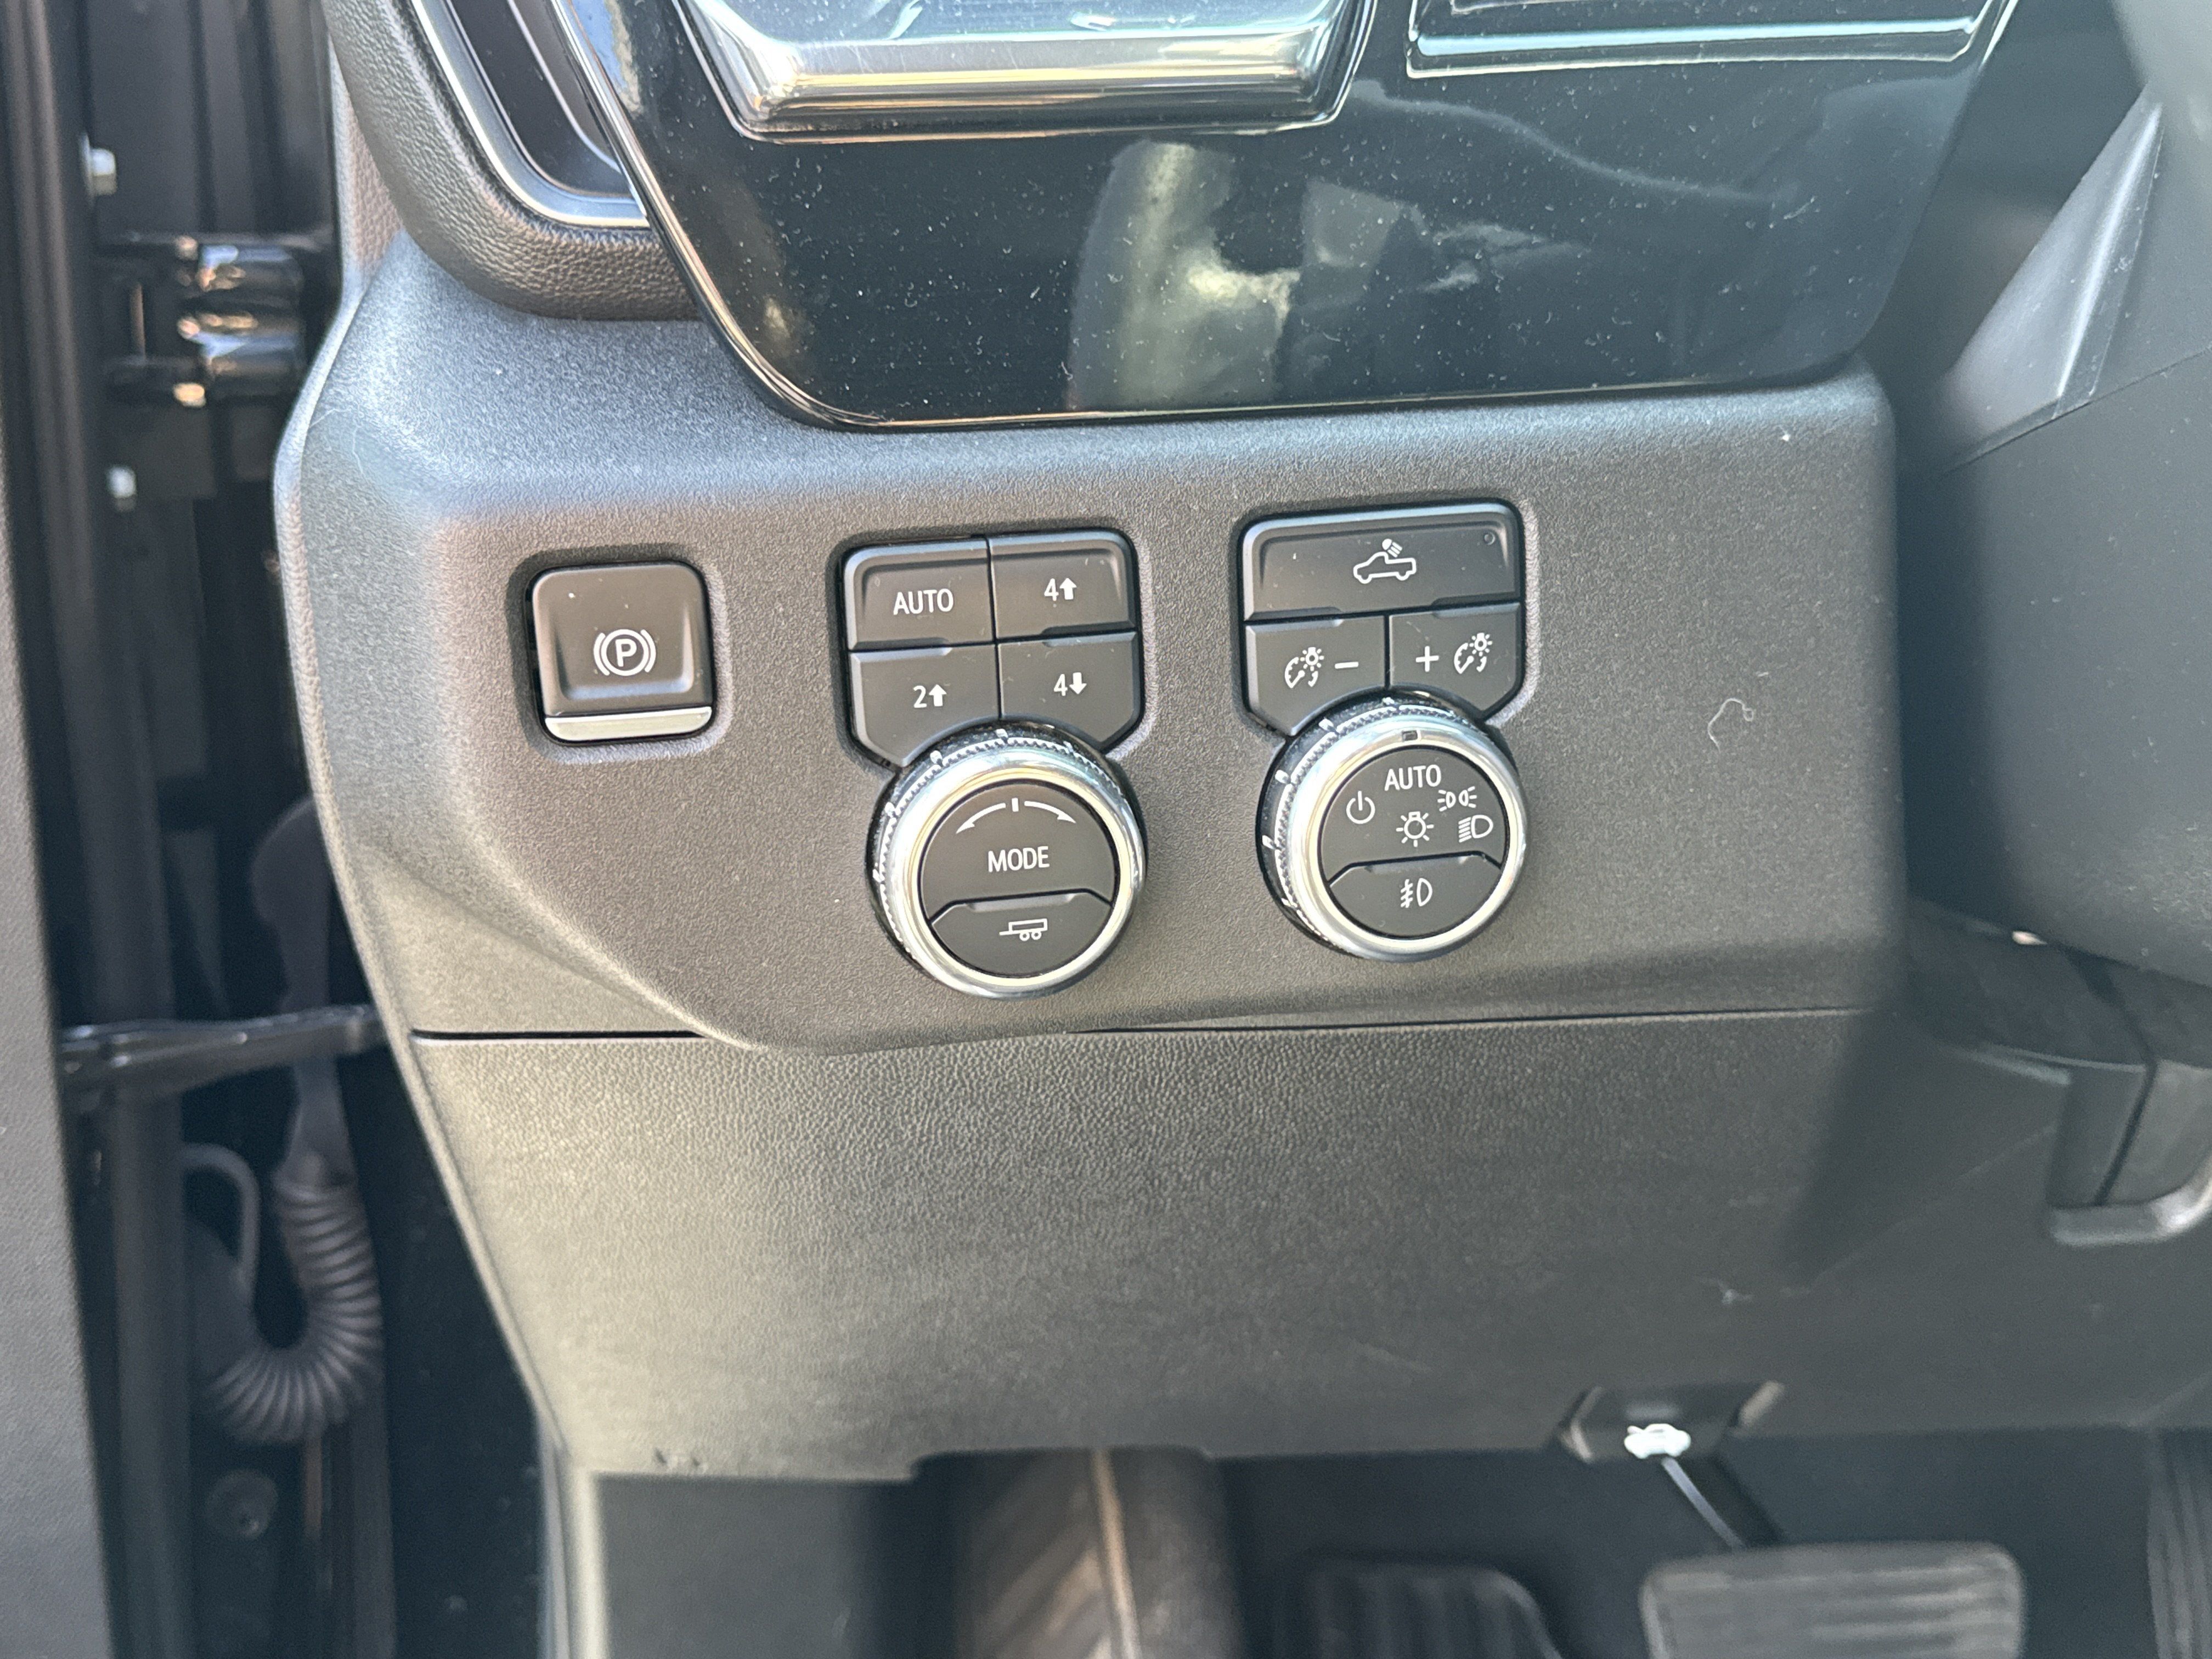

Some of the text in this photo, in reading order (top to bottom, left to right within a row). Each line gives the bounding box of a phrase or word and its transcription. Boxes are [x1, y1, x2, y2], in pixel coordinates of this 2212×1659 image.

[893, 589, 954, 614] AUTO
[1044, 579, 1059, 601] 4
[615, 638, 637, 667] P
[913, 686, 927, 708] 2
[1053, 674, 1068, 696] 4
[1384, 765, 1441, 791] AUTO
[988, 846, 1049, 872] MODE
